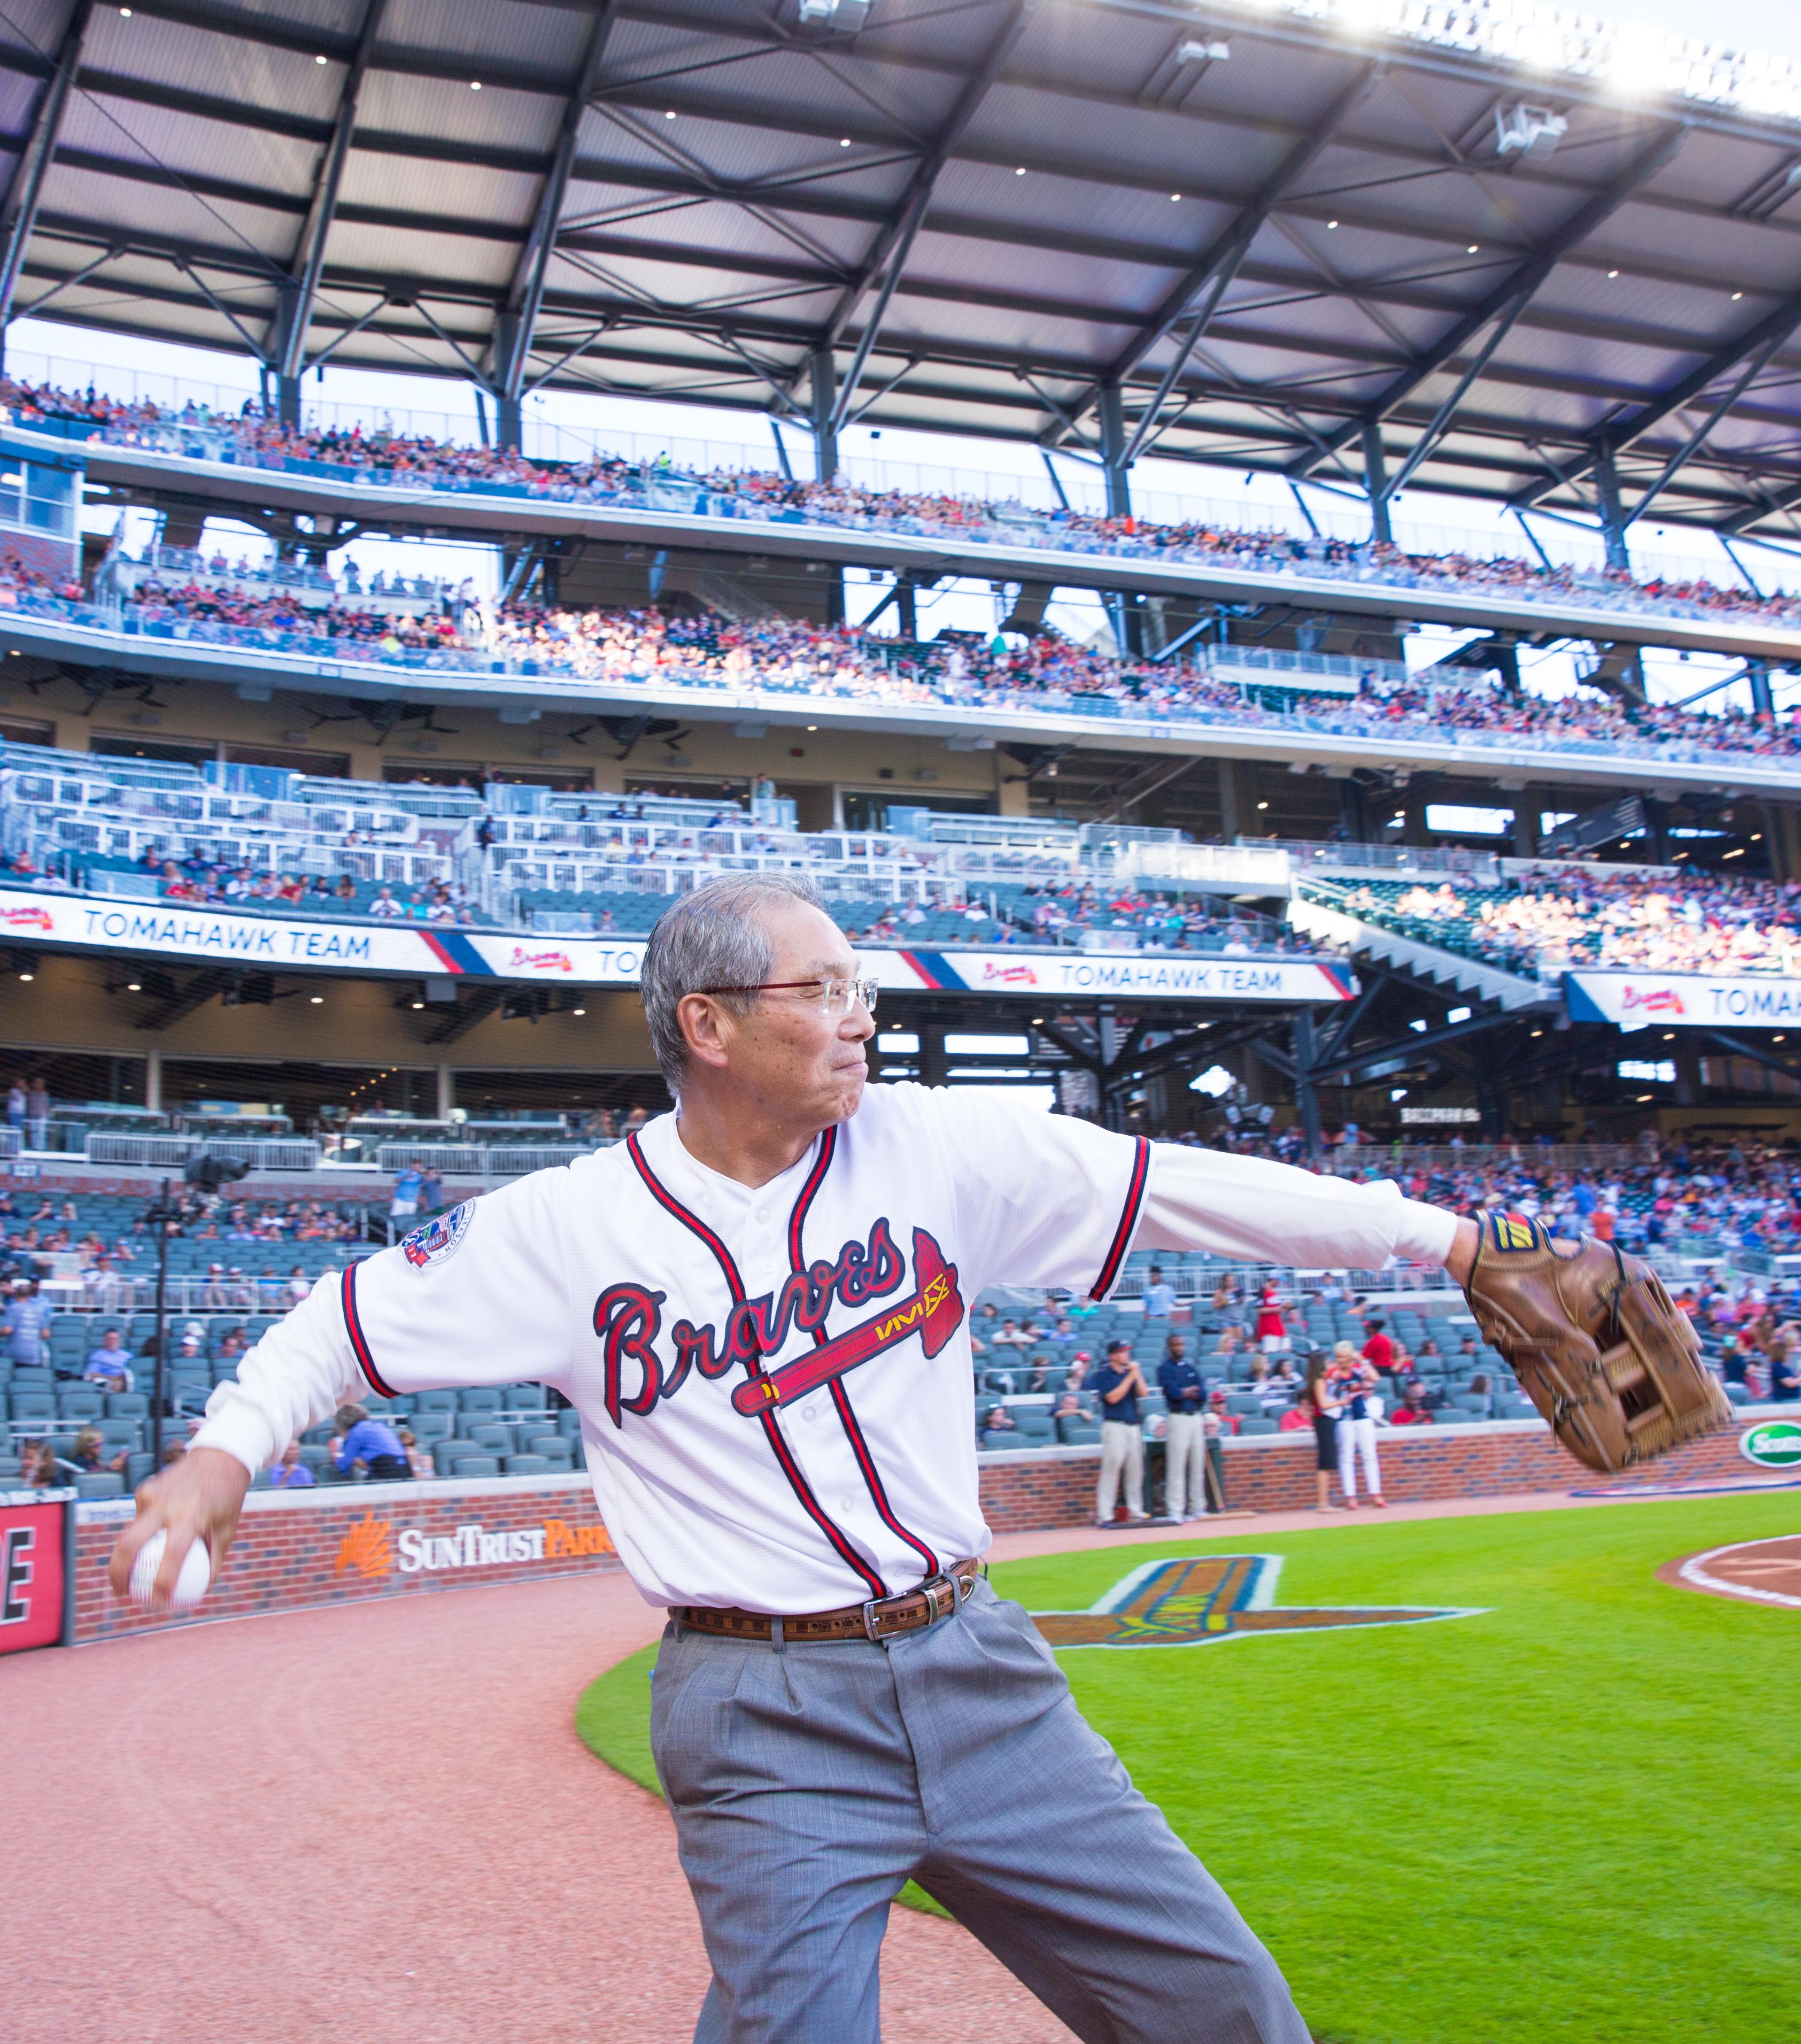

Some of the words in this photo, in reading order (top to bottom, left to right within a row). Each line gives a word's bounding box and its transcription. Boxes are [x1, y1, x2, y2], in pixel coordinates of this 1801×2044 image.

[84, 909, 277, 954] TOMAHAWK
[288, 931, 371, 960] TEAM
[1060, 965, 1210, 989] TOMAHAWK
[1218, 969, 1283, 991] TEAM
[593, 1216, 906, 1429] Braves
